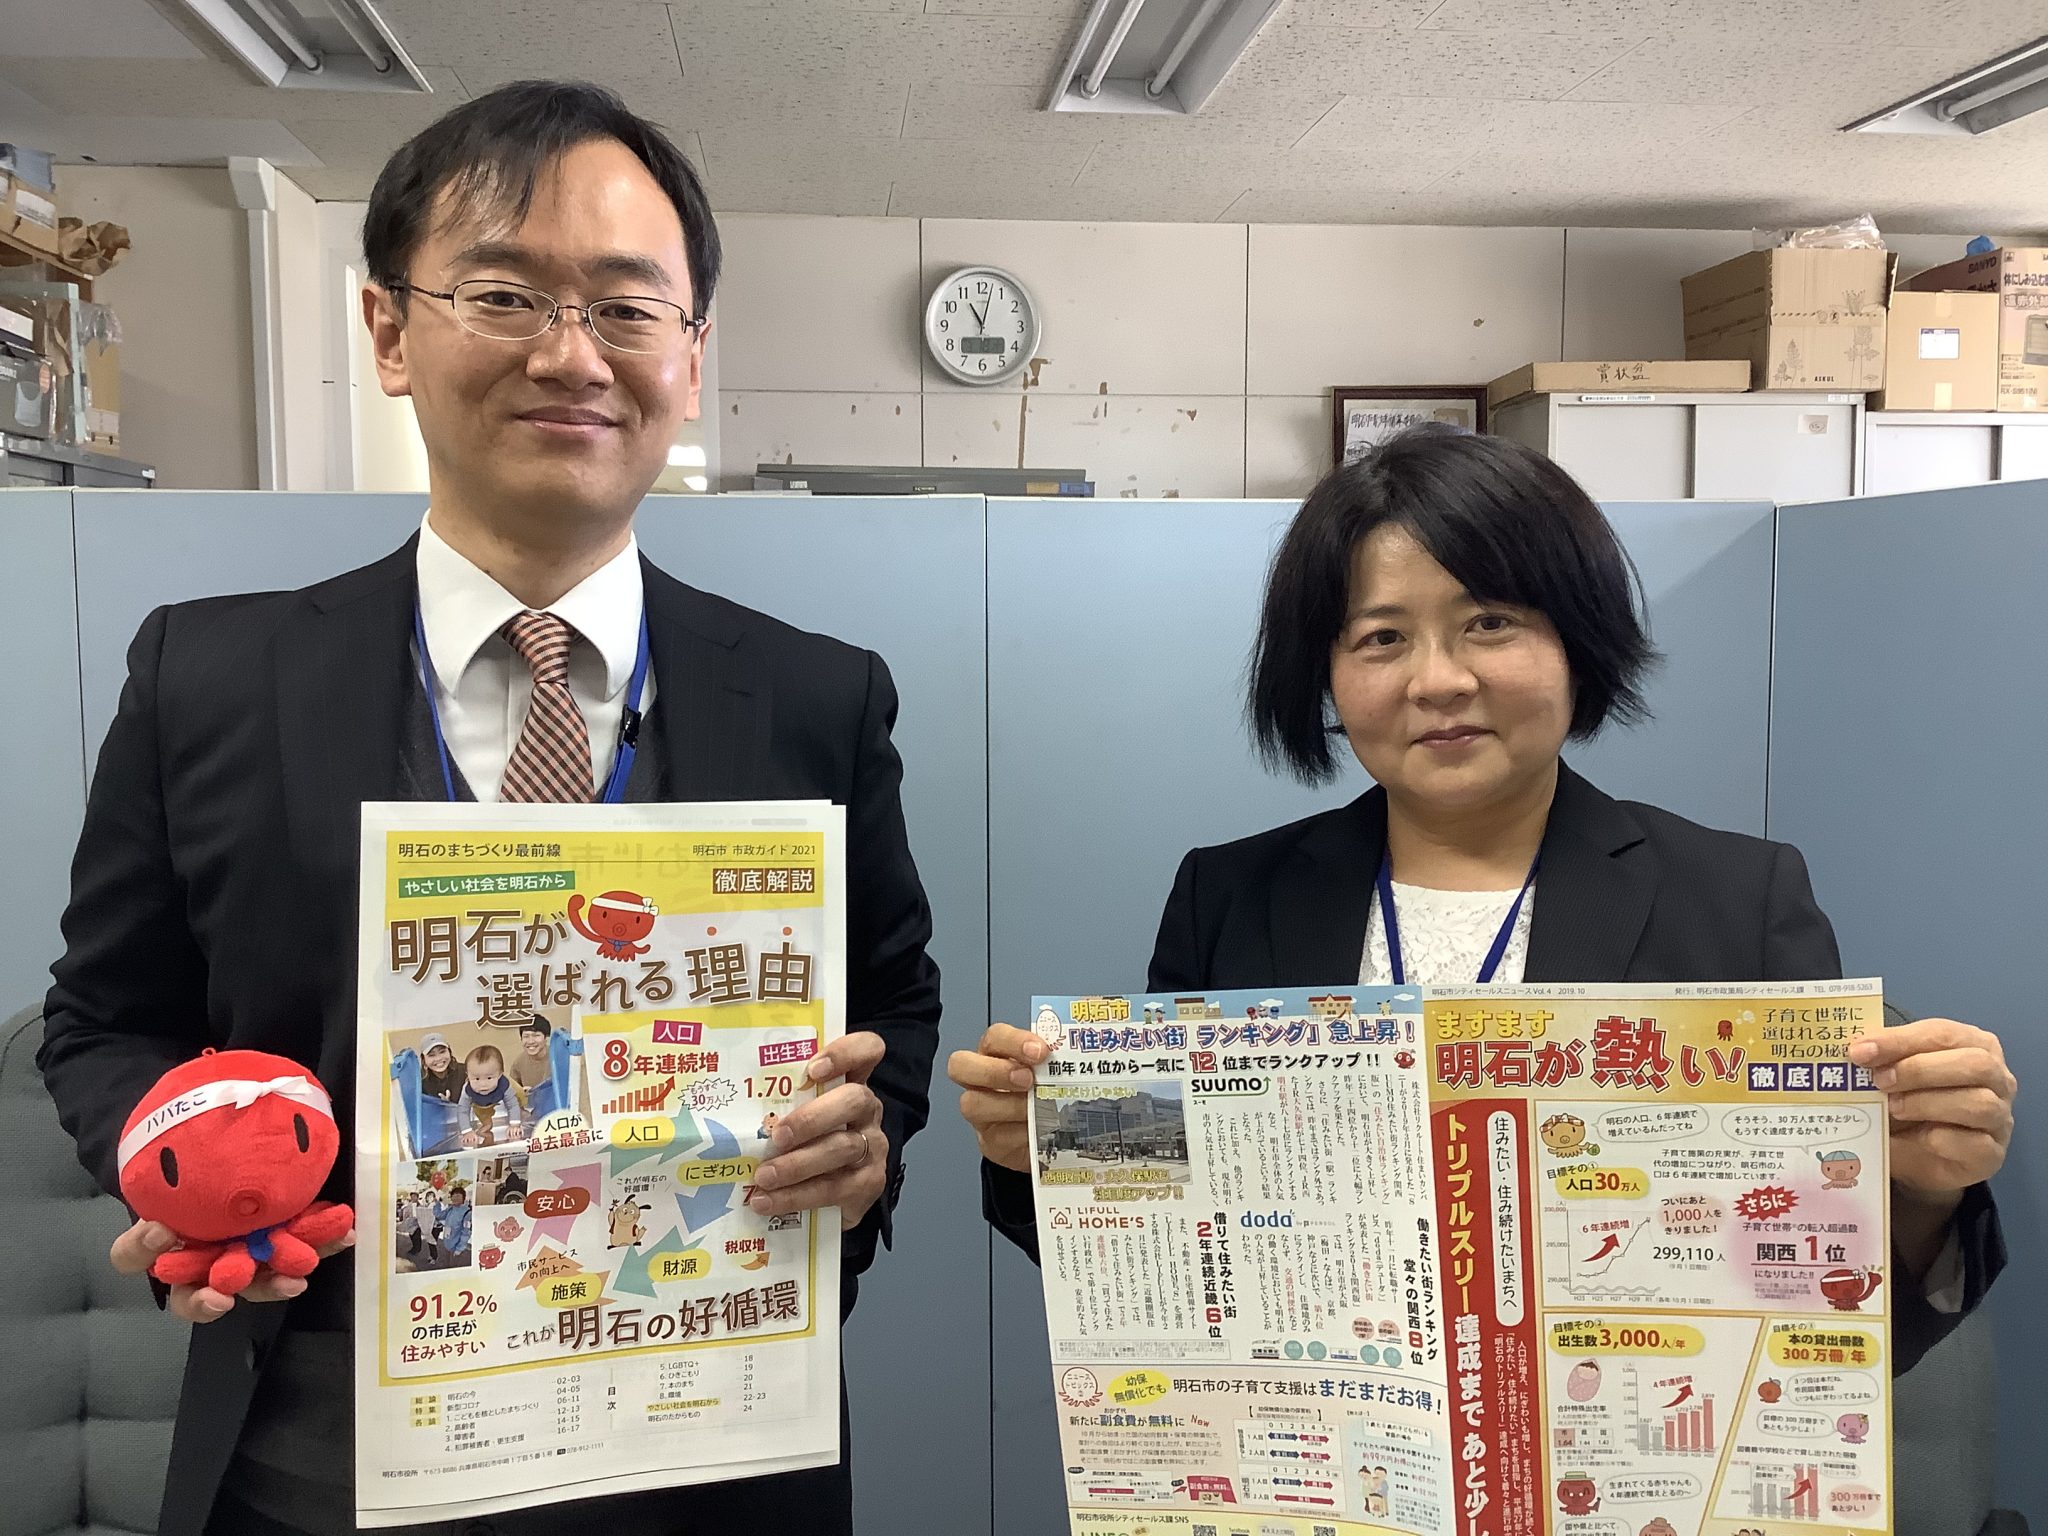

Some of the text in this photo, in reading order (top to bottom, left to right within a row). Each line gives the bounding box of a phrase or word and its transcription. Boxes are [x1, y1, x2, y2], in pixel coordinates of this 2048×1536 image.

[958, 286, 968, 299] 11
[976, 282, 988, 294] 12
[999, 288, 1004, 299] 1
[945, 301, 957, 313] 10
[1011, 301, 1018, 313] 2
[940, 320, 949, 332] 9
[1017, 320, 1024, 333] 3
[946, 339, 954, 351] 8
[1011, 340, 1019, 352] 4
[961, 355, 968, 366] 7
[978, 358, 987, 371] 6
[998, 355, 1006, 367] 5
[398, 843, 561, 859] 明石のまちづくり最前線
[692, 844, 816, 856] 明石市 市政ガイド 2021
[405, 872, 567, 896] やさしい社会を明石から
[715, 869, 814, 893] 徹底解説
[388, 909, 568, 984] 明石が
[1432, 987, 1532, 996] 明石市シティセールスニュース
[1070, 1000, 1130, 1022] 明石市
[1761, 1007, 1865, 1023] 子育て世帯に
[657, 1023, 695, 1042] 人口
[1437, 1009, 1555, 1039] ますます
[602, 1039, 720, 1079] 8年連続増
[762, 1041, 813, 1065] 出生率
[743, 1076, 793, 1098] 1.70
[544, 1114, 583, 1133] 人口が
[1608, 1123, 1693, 1138] 増えているんだってね
[526, 1129, 604, 1155] 過去最高に
[625, 1126, 659, 1143] 人口
[616, 1175, 667, 1187] これが明石の
[685, 1163, 753, 1181] にぎわい
[1566, 1172, 1641, 1192] 人口30万人
[537, 1194, 575, 1213] 安心
[1661, 1196, 1707, 1206] ついにあと
[1744, 1193, 1788, 1213] さらに
[1077, 1207, 1120, 1215] LIFULL
[1240, 1210, 1293, 1228] doda
[1079, 1217, 1145, 1229] HOME'S
[1582, 1219, 1630, 1233] 6年連続増
[724, 1237, 766, 1255] 税収増
[1756, 1235, 1846, 1262] 関西1位
[517, 1249, 579, 1272] 市民サービス
[663, 1258, 698, 1276] 財源
[1214, 1211, 1237, 1319] 借りて住みたい街
[529, 1263, 571, 1280] の向上へ
[1196, 1221, 1223, 1338] 2年連続近畿6位
[551, 1282, 587, 1301] 施策
[1416, 1217, 1438, 1361] 働きたい街ランキング
[409, 1290, 498, 1322] 91.2%
[1403, 1258, 1424, 1366] 堂々の関西8位
[411, 1320, 478, 1341] の市民が
[1788, 1334, 1865, 1348] 本の貸出冊数
[400, 1339, 487, 1365] 住みやすい
[1125, 1374, 1148, 1386] 幼保
[1114, 1384, 1167, 1403] 無償化でも
